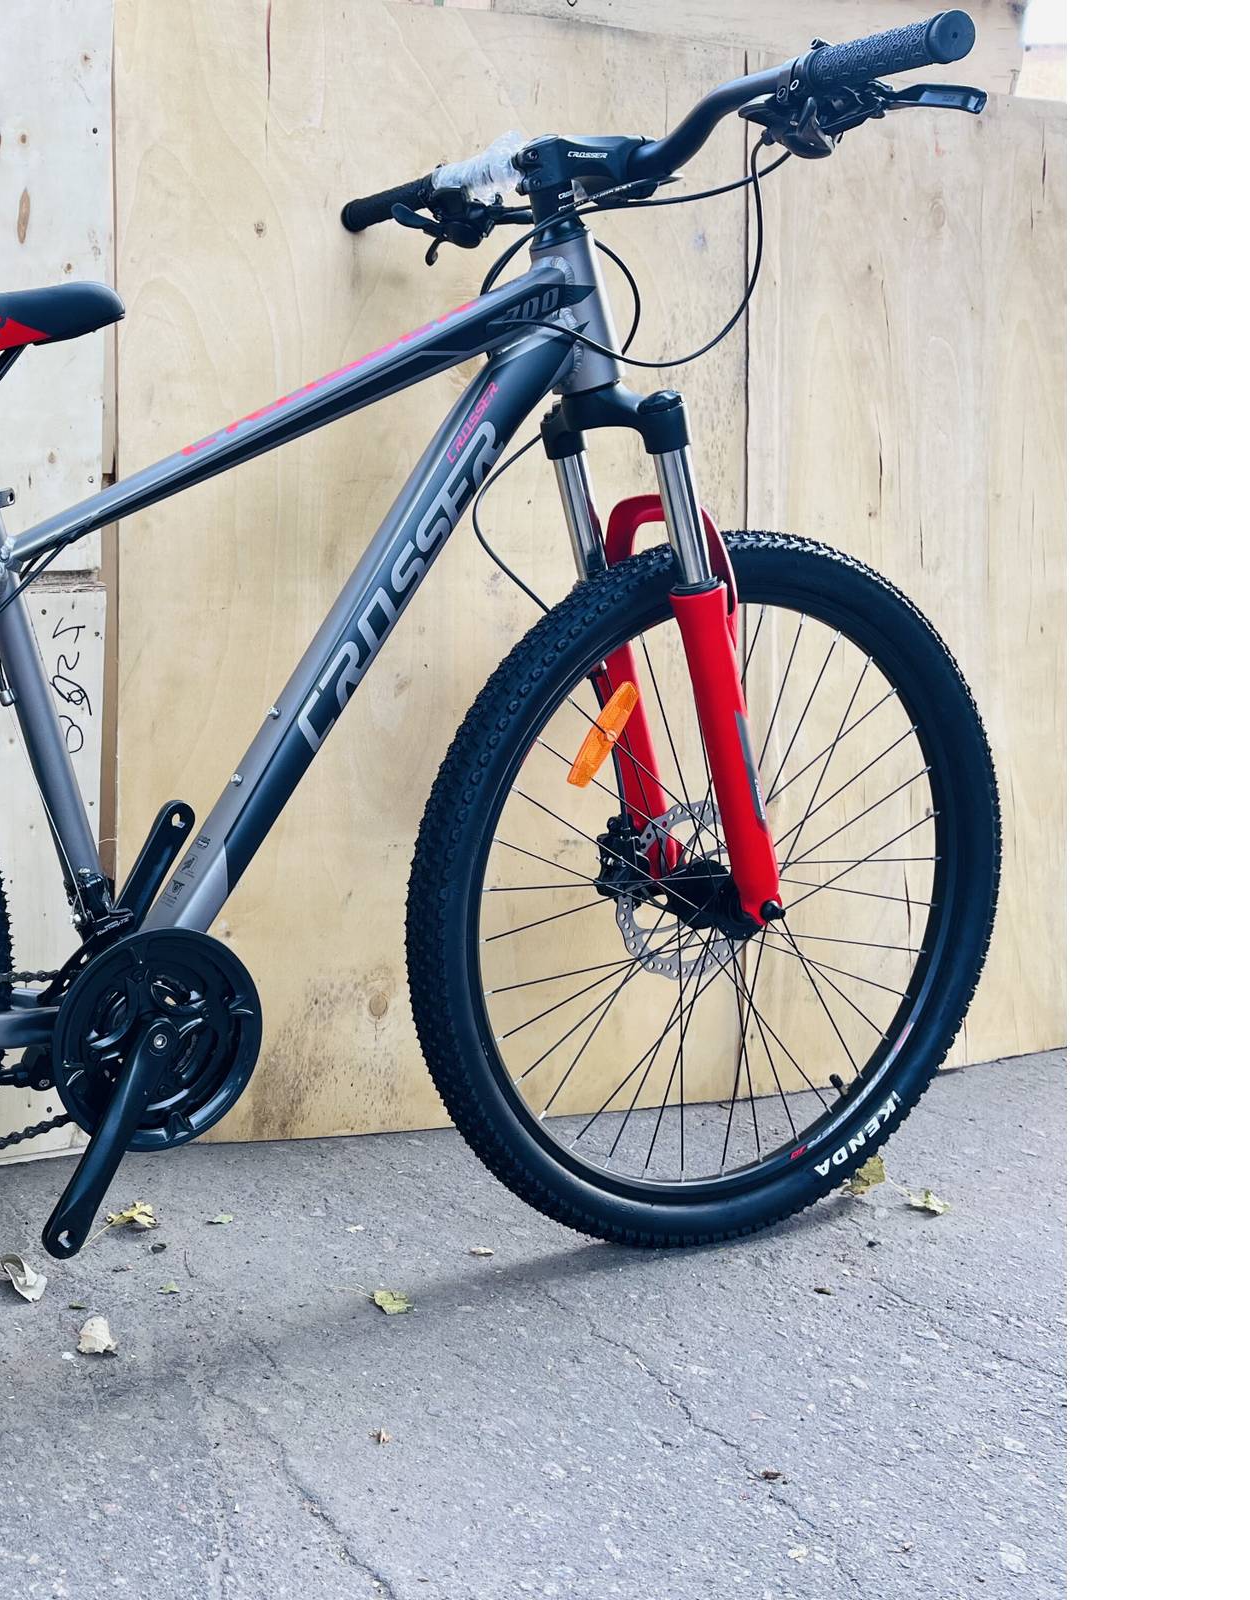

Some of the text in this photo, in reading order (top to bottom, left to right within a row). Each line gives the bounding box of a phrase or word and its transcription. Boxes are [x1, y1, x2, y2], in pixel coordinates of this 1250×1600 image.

[567, 150, 608, 159] CROSSER
[446, 381, 499, 464] CROSSER
[297, 420, 506, 753] CROSSER
[814, 1097, 898, 1177] KENDA
